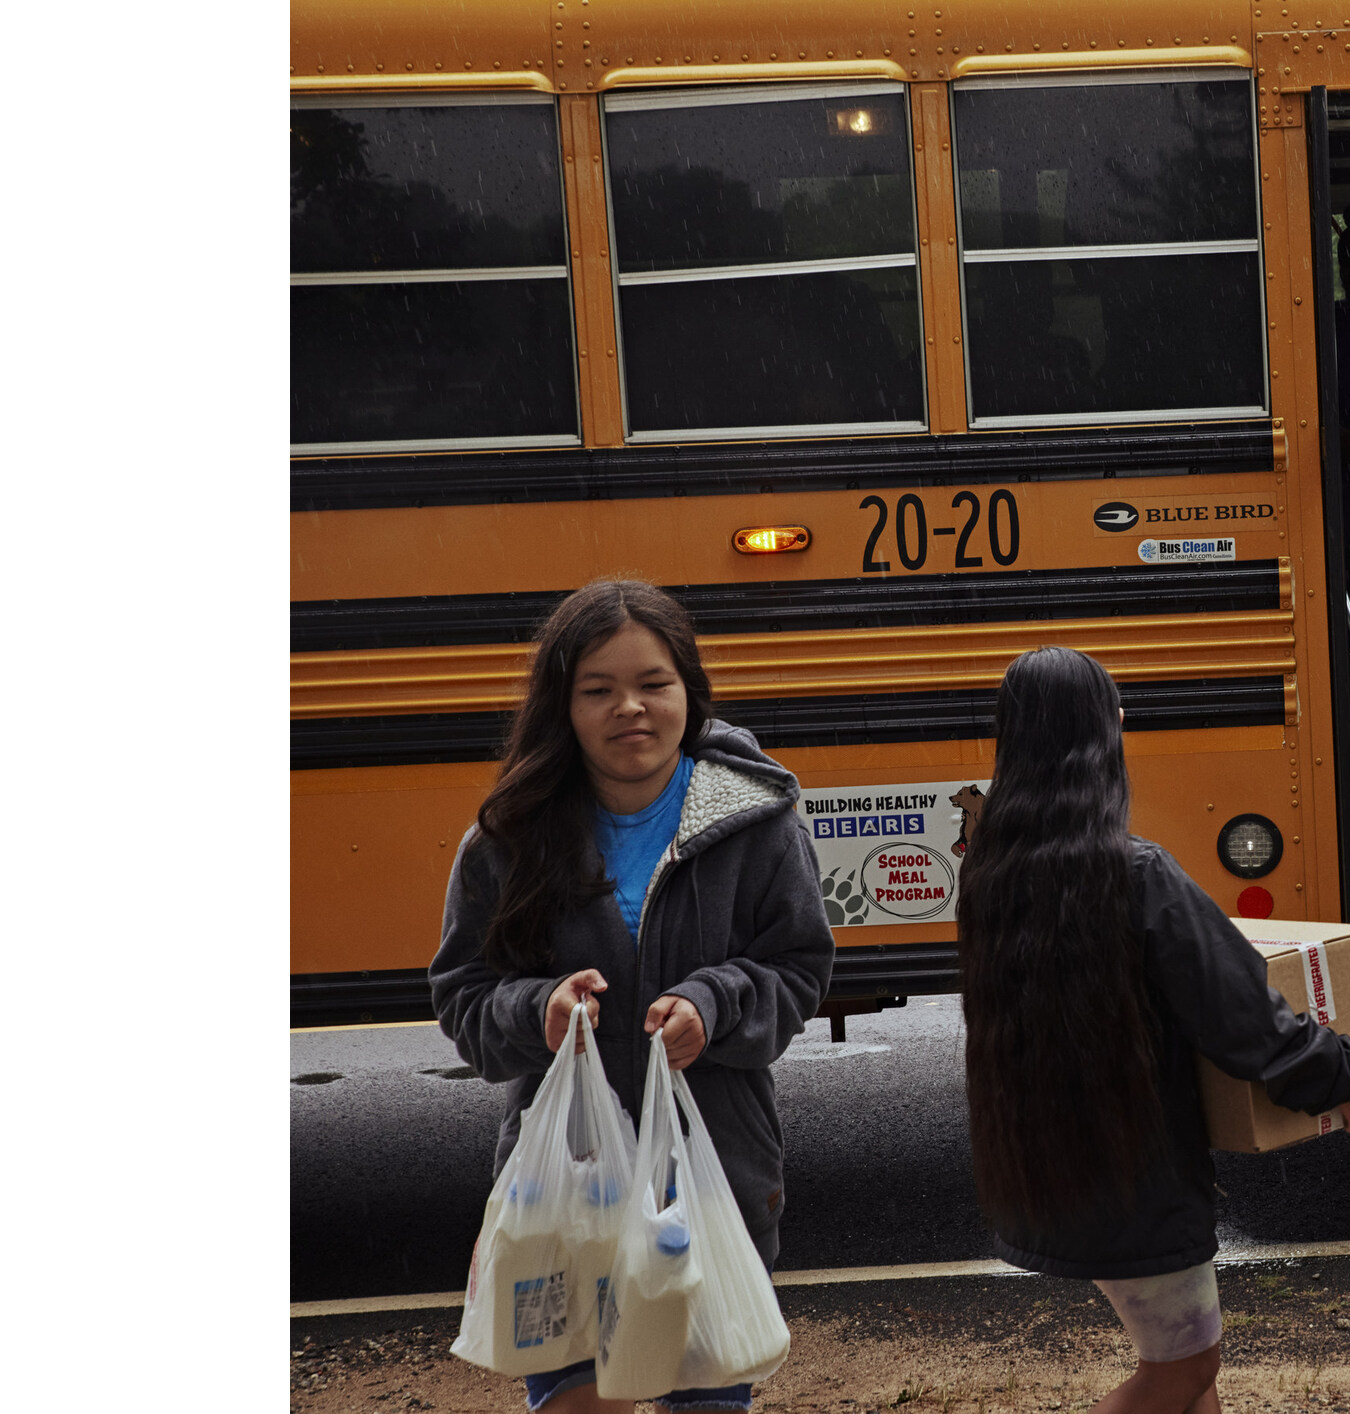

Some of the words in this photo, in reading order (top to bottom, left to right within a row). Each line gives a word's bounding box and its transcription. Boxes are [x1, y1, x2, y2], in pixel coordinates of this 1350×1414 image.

[1144, 506, 1209, 523] BLUE
[1214, 504, 1275, 520] BIRD
[858, 488, 1020, 573] 20-20
[1160, 542, 1181, 554] Bus
[1182, 541, 1215, 553] Clean
[1216, 539, 1233, 552] Air
[805, 797, 872, 814] BUILDING
[875, 794, 938, 811] HEALTHY
[817, 817, 920, 836] BEARS
[877, 853, 933, 869] SCHOOL
[887, 870, 928, 885] MEAL
[875, 886, 946, 903] PROGRAM
[1317, 1010, 1330, 1026] EEP
